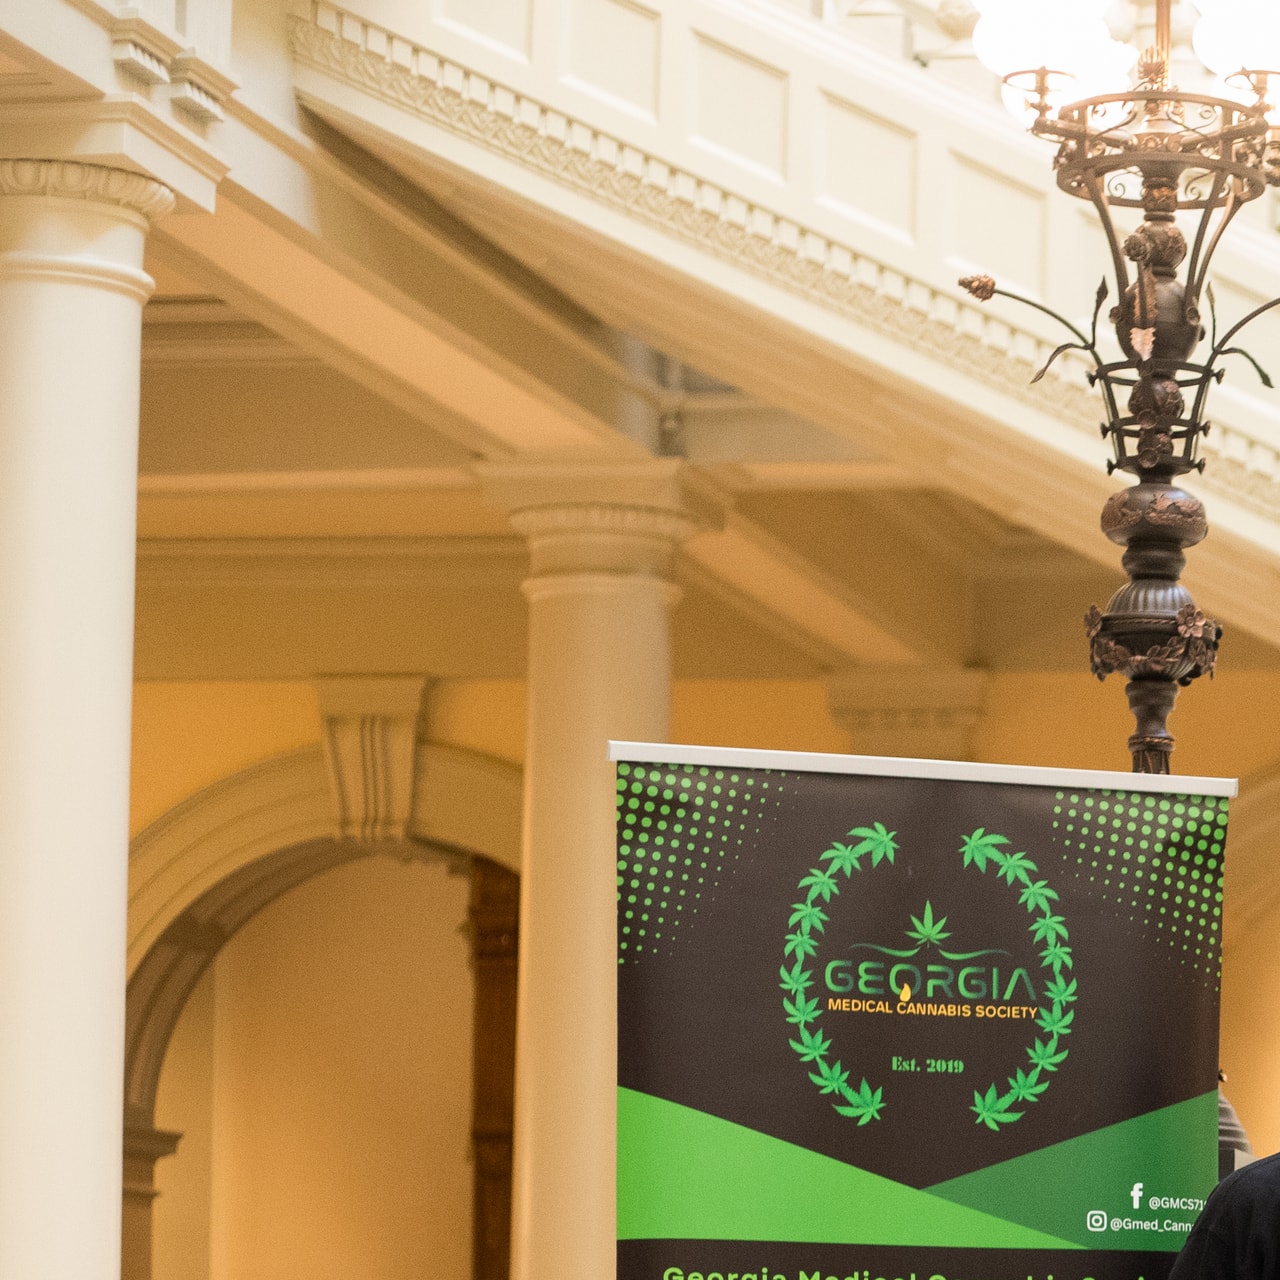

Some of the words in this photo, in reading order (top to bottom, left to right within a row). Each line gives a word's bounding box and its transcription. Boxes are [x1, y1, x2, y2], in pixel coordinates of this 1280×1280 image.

[825, 959, 1037, 1001] GEORGIA
[829, 998, 892, 1013] MEDICAL
[897, 1000, 971, 1017] CANNABIS
[976, 1005, 1037, 1018] SOCIETY
[892, 1057, 920, 1071] Est.
[927, 1059, 964, 1072] 2019
[1149, 1197, 1206, 1211] @GMCS71
[1110, 1218, 1194, 1232] @Gmed_Cann
